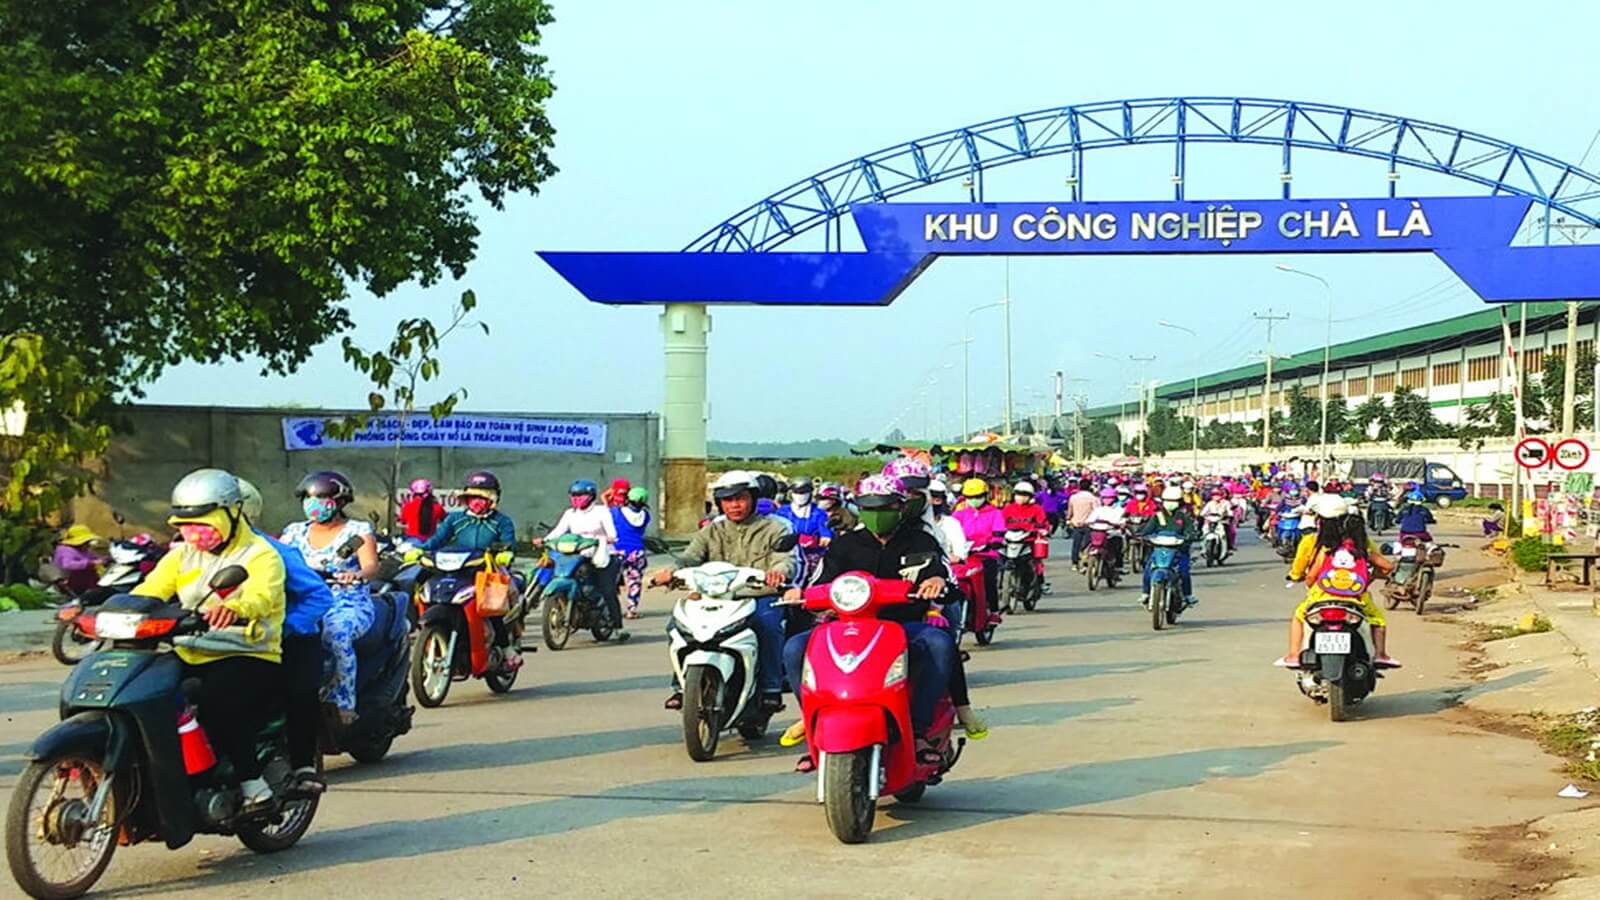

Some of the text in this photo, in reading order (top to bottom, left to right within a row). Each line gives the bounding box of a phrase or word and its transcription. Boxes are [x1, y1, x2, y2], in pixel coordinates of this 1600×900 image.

[924, 213, 998, 241] KHU
[1012, 206, 1117, 241] CÔNG
[1278, 202, 1361, 238] CHÀ
[1375, 201, 1433, 237] LÀ
[474, 420, 487, 429] AN
[526, 423, 547, 433] SINH
[548, 424, 565, 433] LAO
